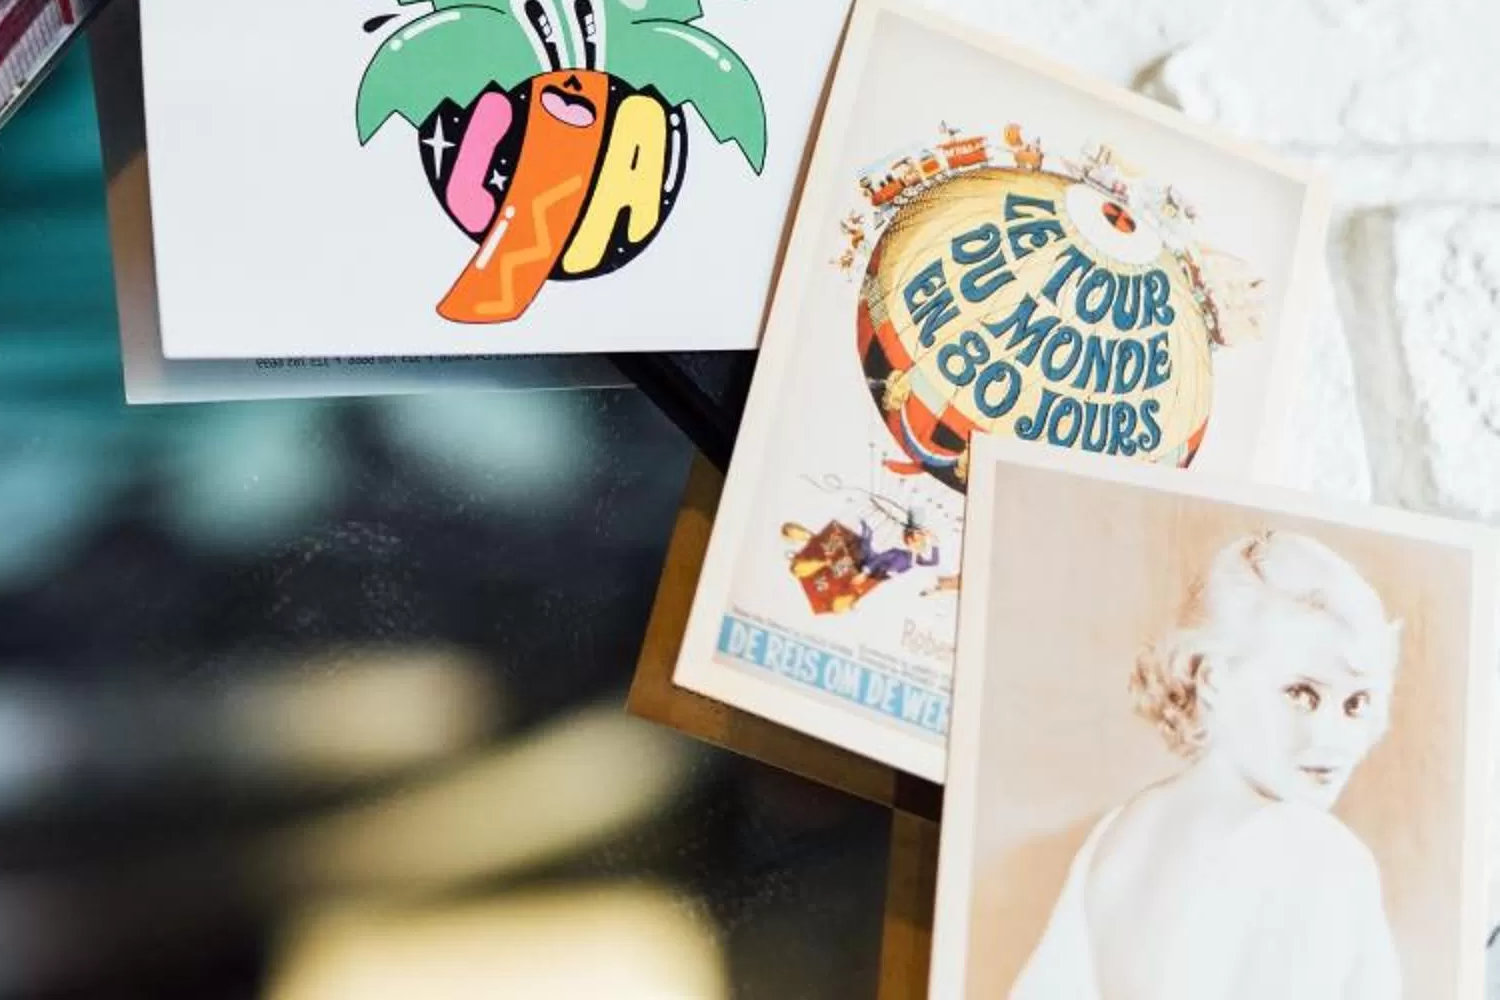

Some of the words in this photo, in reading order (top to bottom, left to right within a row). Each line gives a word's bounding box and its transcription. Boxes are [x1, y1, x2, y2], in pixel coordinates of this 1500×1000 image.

[950, 221, 1017, 304] DU
[1004, 191, 1067, 261] LE
[1041, 244, 1176, 332] TOUR
[902, 256, 962, 348] EN
[935, 329, 1024, 419] 80
[1014, 387, 1164, 457] JOURS
[979, 292, 1174, 394] MONDE
[728, 620, 767, 661] DE
[762, 634, 822, 689] REIS
[822, 657, 863, 702] OM
[865, 671, 902, 715] DE
